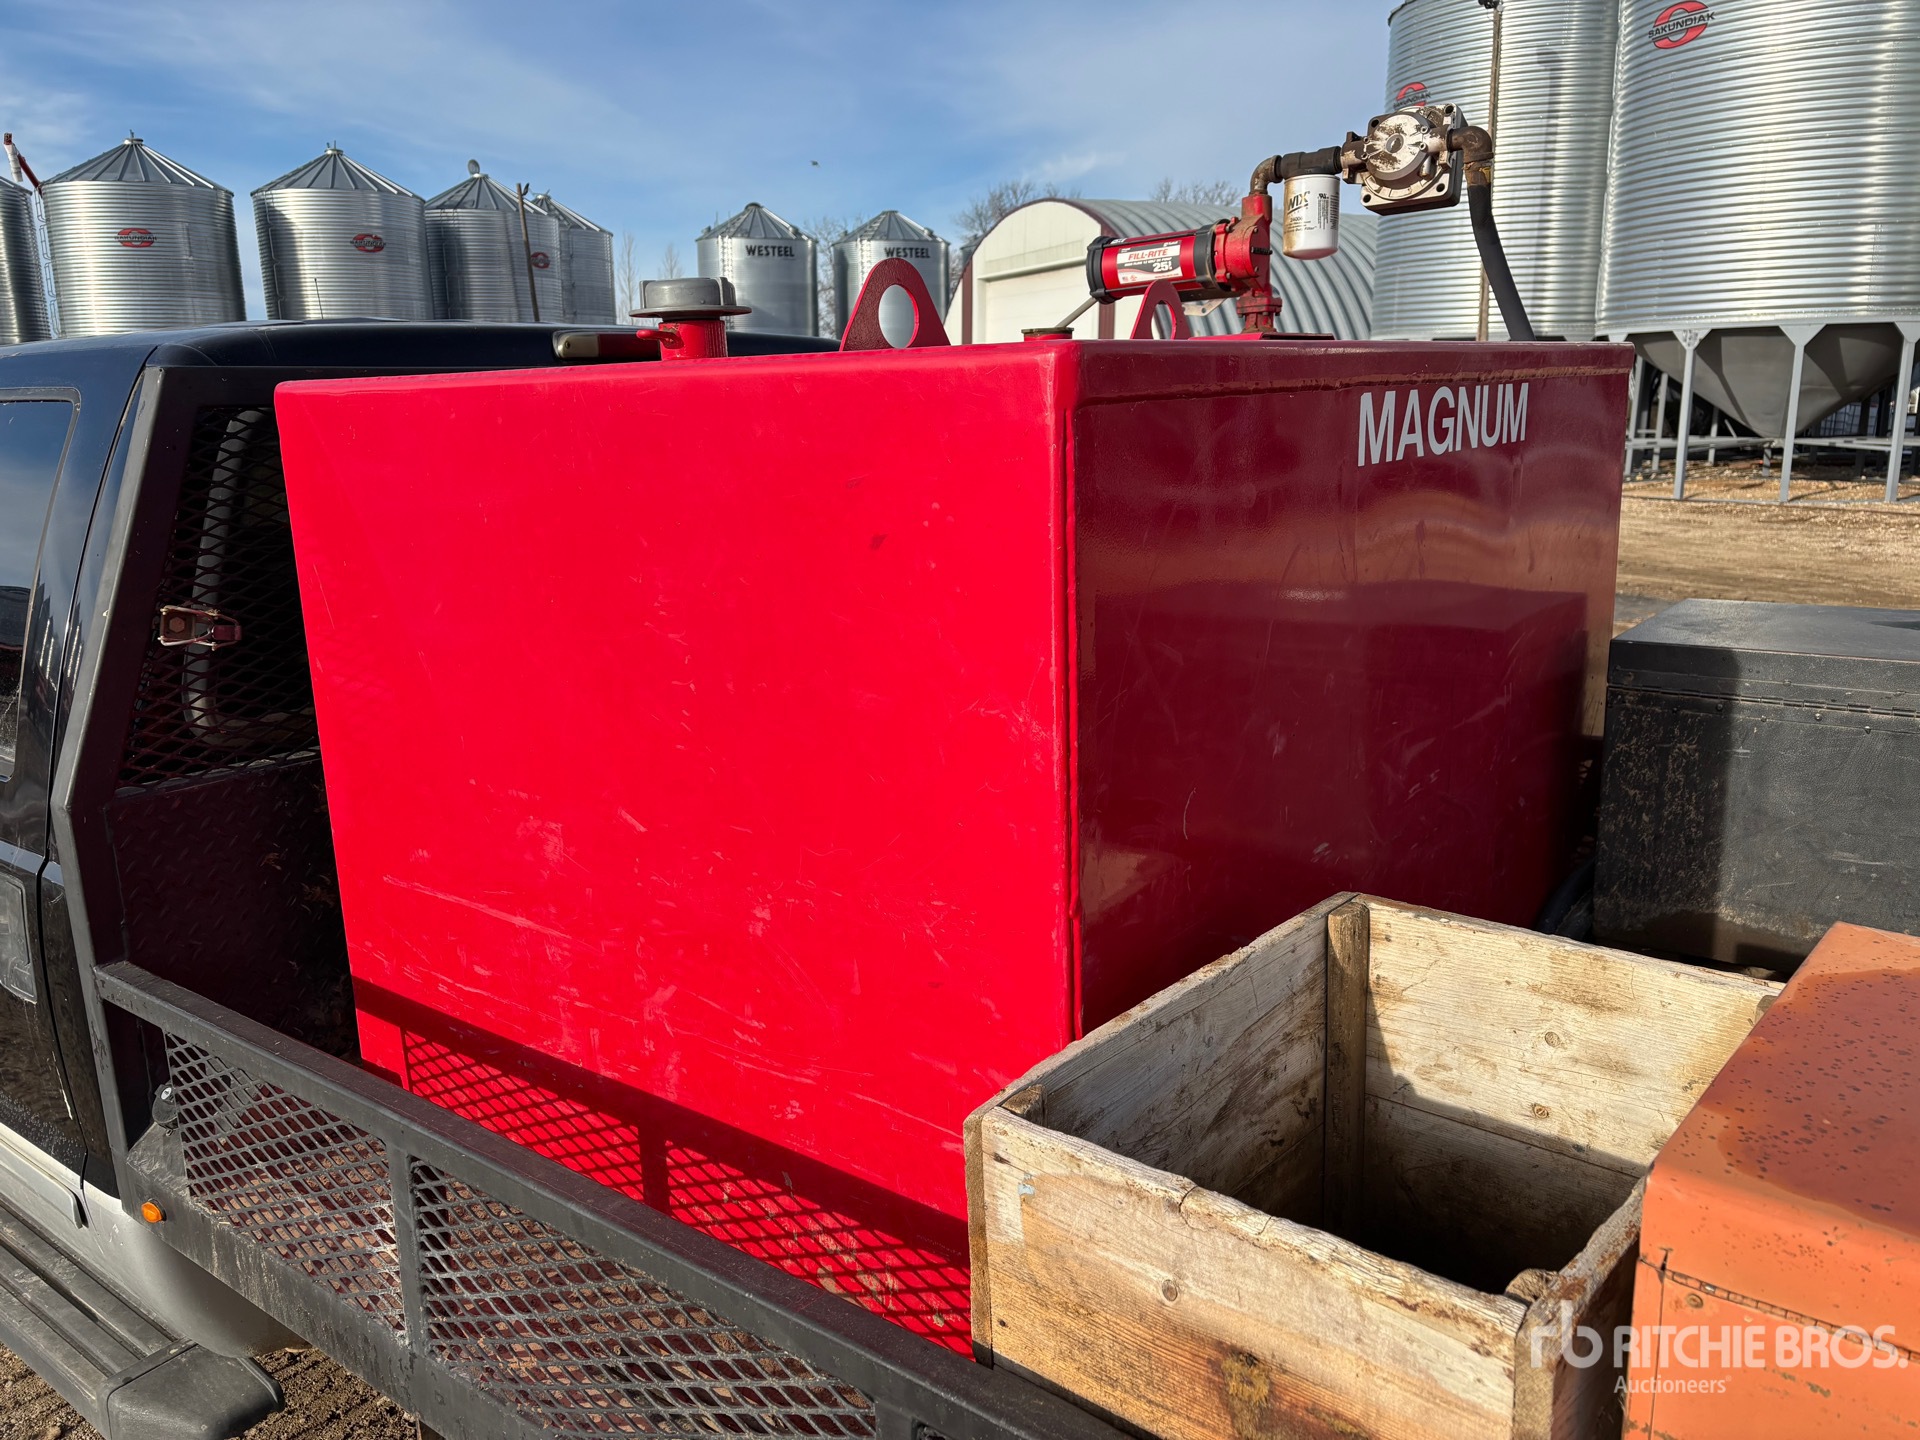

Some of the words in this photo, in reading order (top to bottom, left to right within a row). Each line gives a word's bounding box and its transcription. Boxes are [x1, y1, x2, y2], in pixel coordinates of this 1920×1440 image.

[1648, 11, 1715, 38] SAKUNDIAK
[745, 245, 795, 258] WESTEEL
[884, 247, 931, 259] WESTEEL
[1128, 248, 1168, 261] FILL-RITE
[1152, 261, 1169, 272] 25
[1358, 382, 1529, 467] MAGNUM
